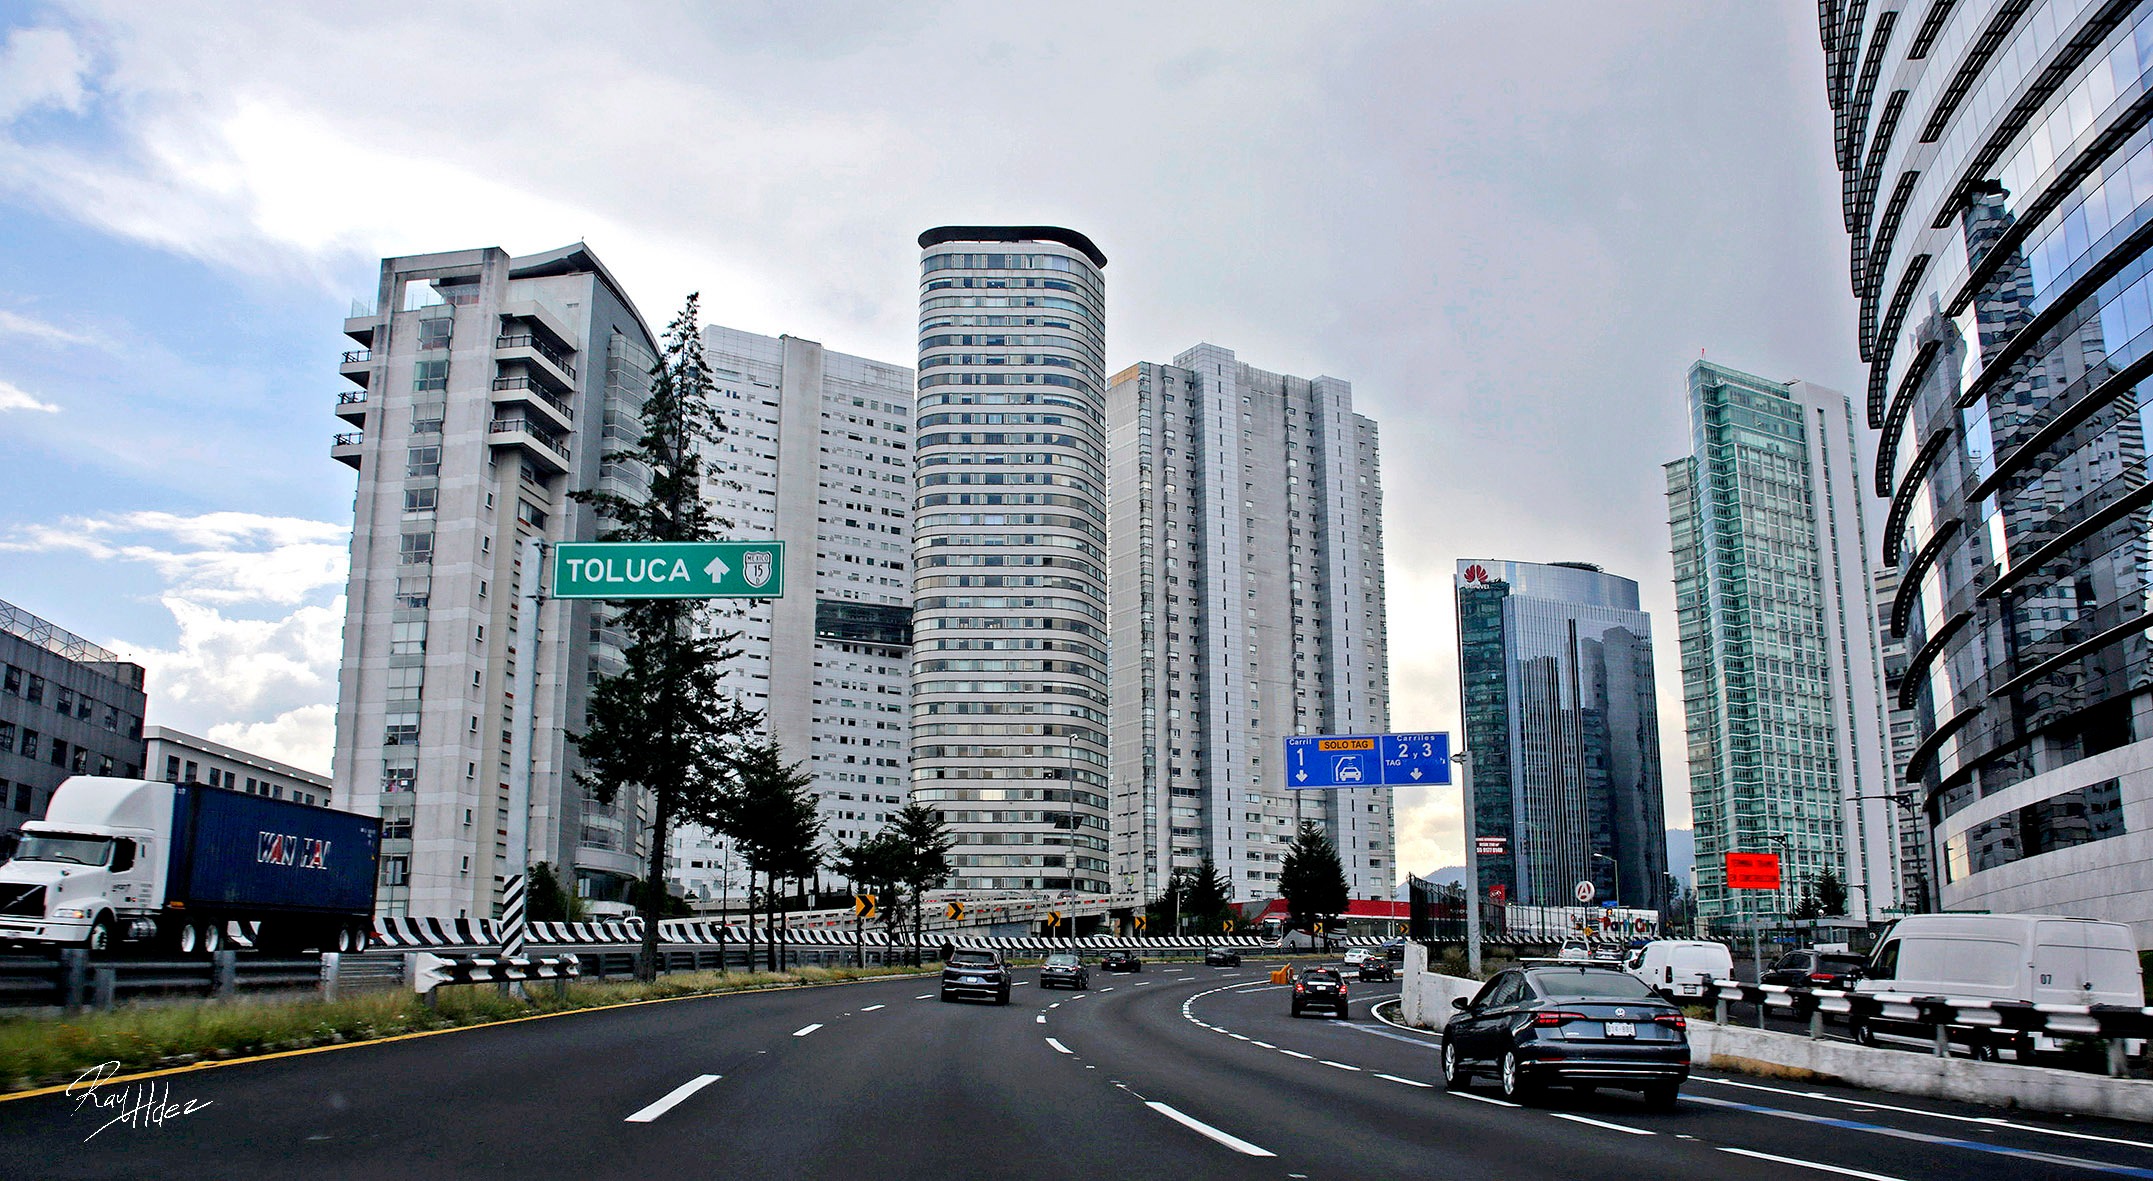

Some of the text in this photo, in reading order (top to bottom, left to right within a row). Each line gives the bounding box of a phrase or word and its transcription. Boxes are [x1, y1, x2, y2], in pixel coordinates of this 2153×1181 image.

[566, 558, 691, 583] TOLUCA
[754, 565, 763, 577] 15
[1289, 738, 1312, 746] Carril
[1324, 740, 1369, 749] SOLO TAG
[1297, 748, 1304, 766] 1
[1398, 743, 1432, 760] 2 y 3
[1385, 759, 1401, 767] TAG
[257, 831, 297, 867] WAN
[1603, 915, 1634, 937] Party
[1635, 917, 1658, 937] City
[2040, 973, 2052, 985] 07
